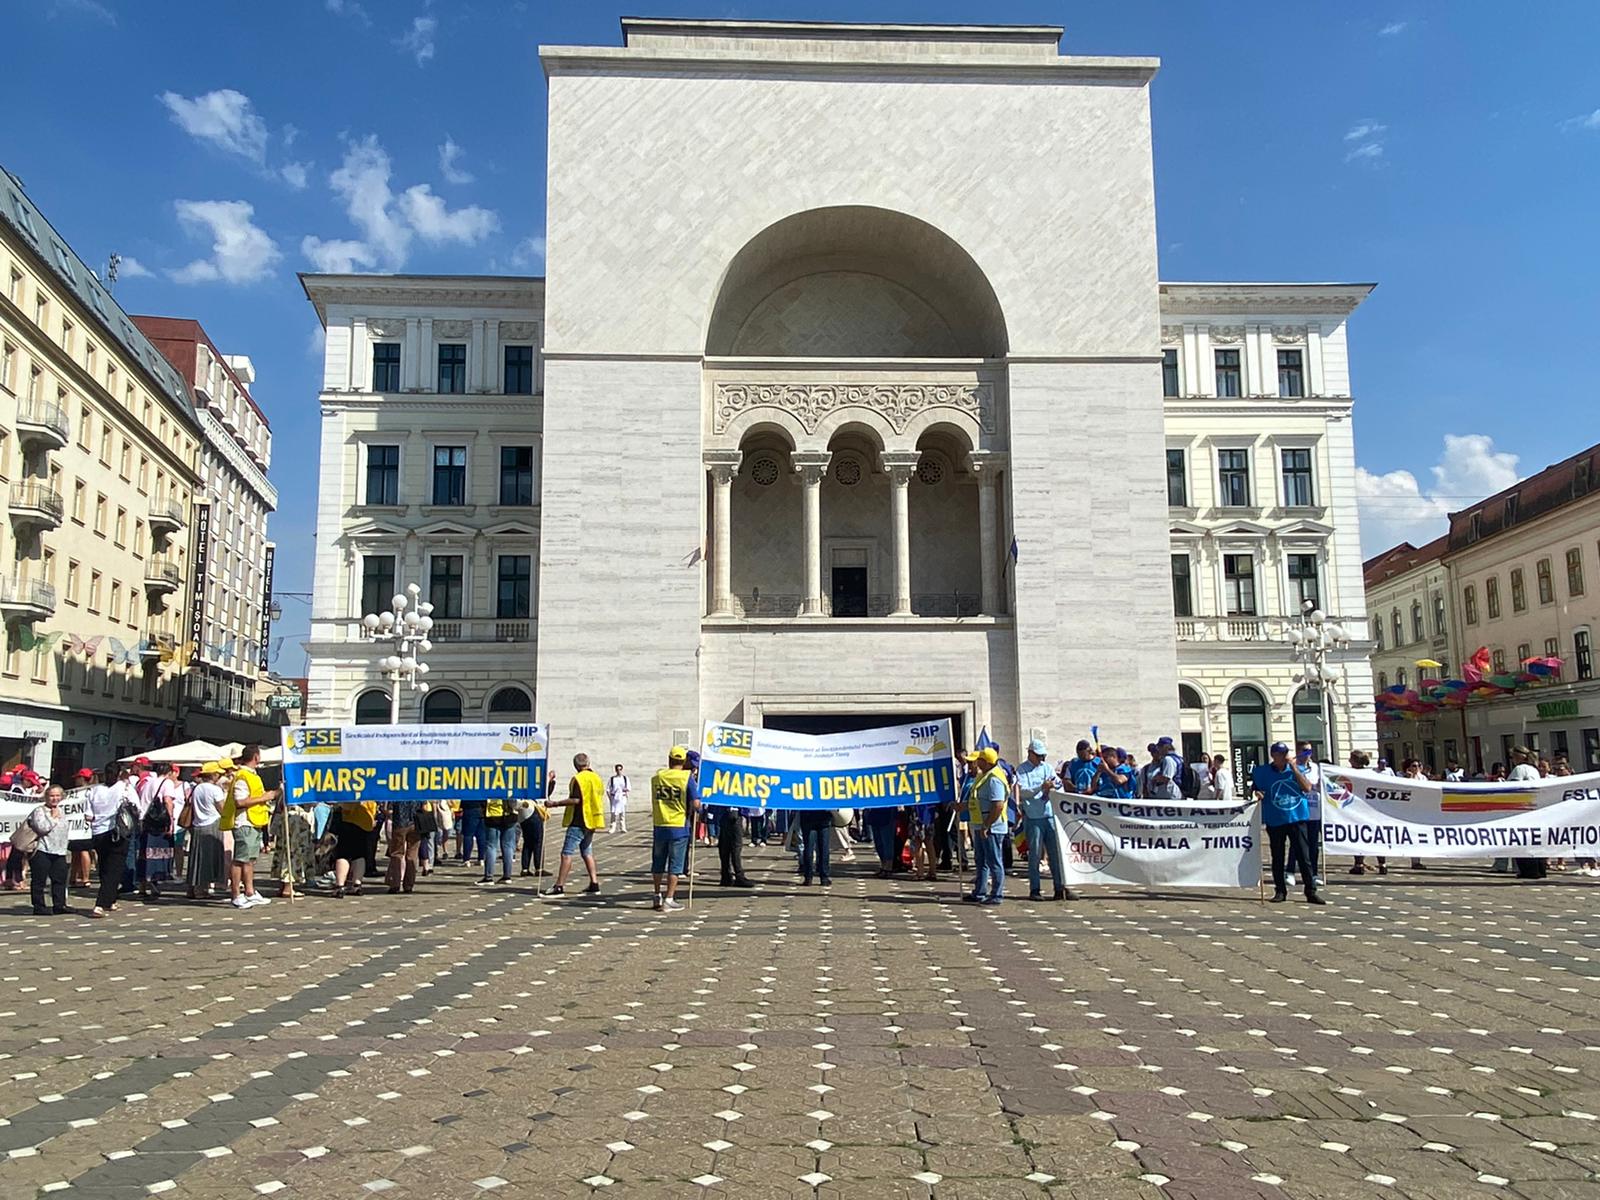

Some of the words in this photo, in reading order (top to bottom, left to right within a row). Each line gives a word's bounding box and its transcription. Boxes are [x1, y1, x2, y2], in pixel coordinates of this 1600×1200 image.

[198, 511, 208, 563] HOTEL
[265, 551, 273, 593] HOTEL
[192, 573, 203, 661] TIMIȘOARA
[305, 729, 341, 745] FSE
[509, 726, 538, 737] SIIP
[723, 729, 752, 748] FSE
[910, 725, 940, 738] SIIP
[416, 760, 528, 798] DEMNITĂȚII
[1234, 748, 1244, 795] infocentru
[819, 765, 936, 803] DEMNITĂȚII
[1060, 801, 1102, 816] CNS
[1120, 837, 1190, 850] FILIALA
[1201, 836, 1253, 852] TIMIȘ
[1323, 824, 1413, 849] EDUCAȚIA
[1434, 827, 1542, 846] PRIORITATE
[1547, 826, 1600, 850] NAȚIO
[1070, 840, 1103, 854] alfa
[1068, 856, 1106, 864] CARTEL
